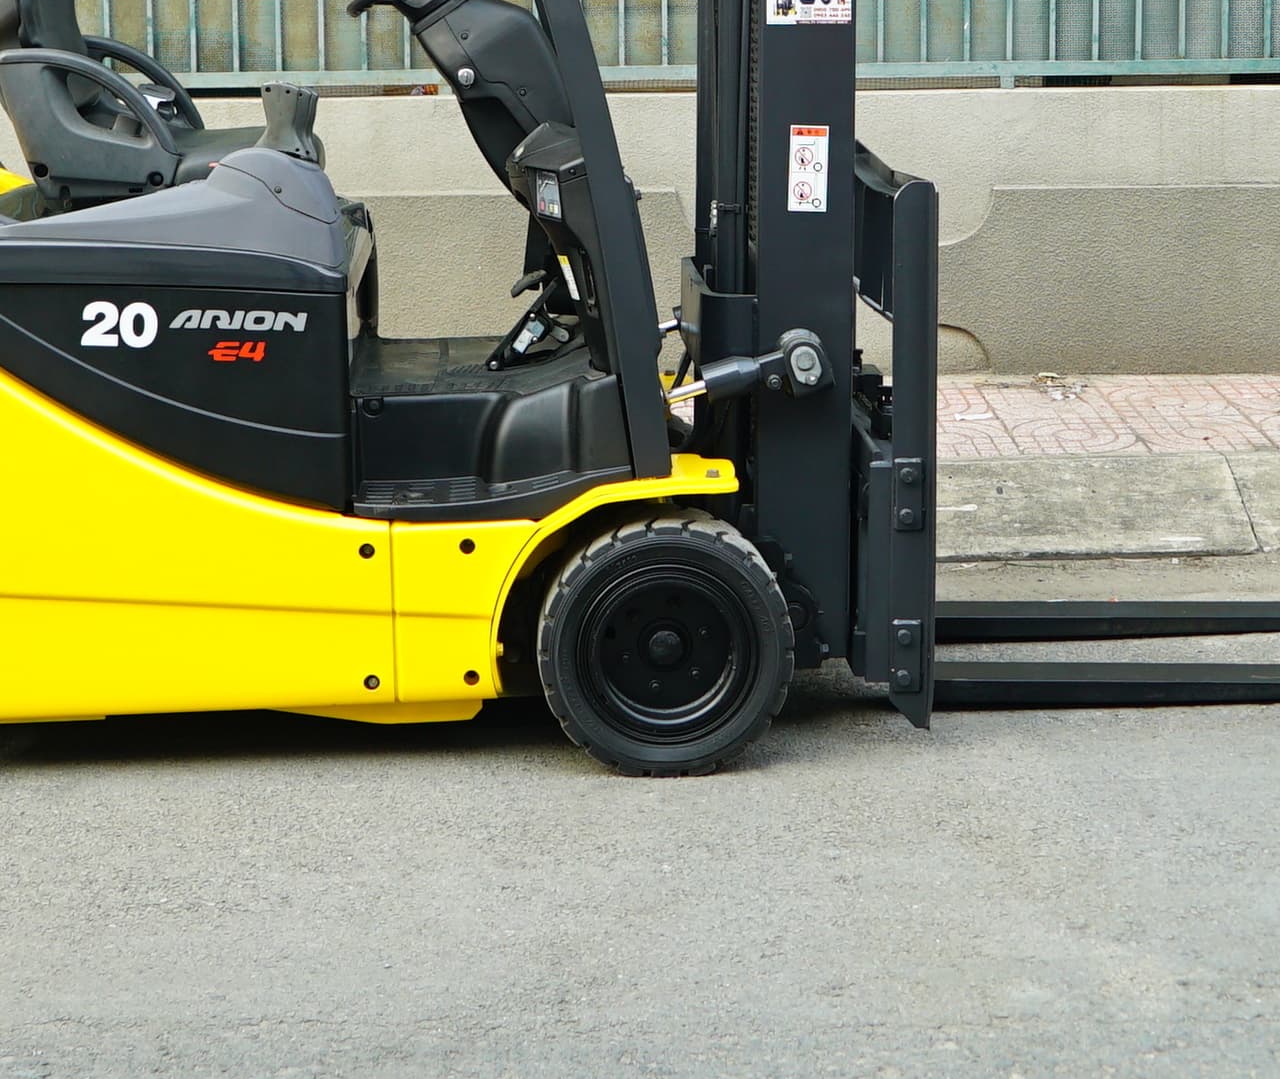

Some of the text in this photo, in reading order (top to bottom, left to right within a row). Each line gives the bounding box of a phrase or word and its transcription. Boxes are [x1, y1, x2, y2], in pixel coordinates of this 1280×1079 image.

[80, 301, 308, 349] 20 ARION
[207, 341, 267, 362] E4
